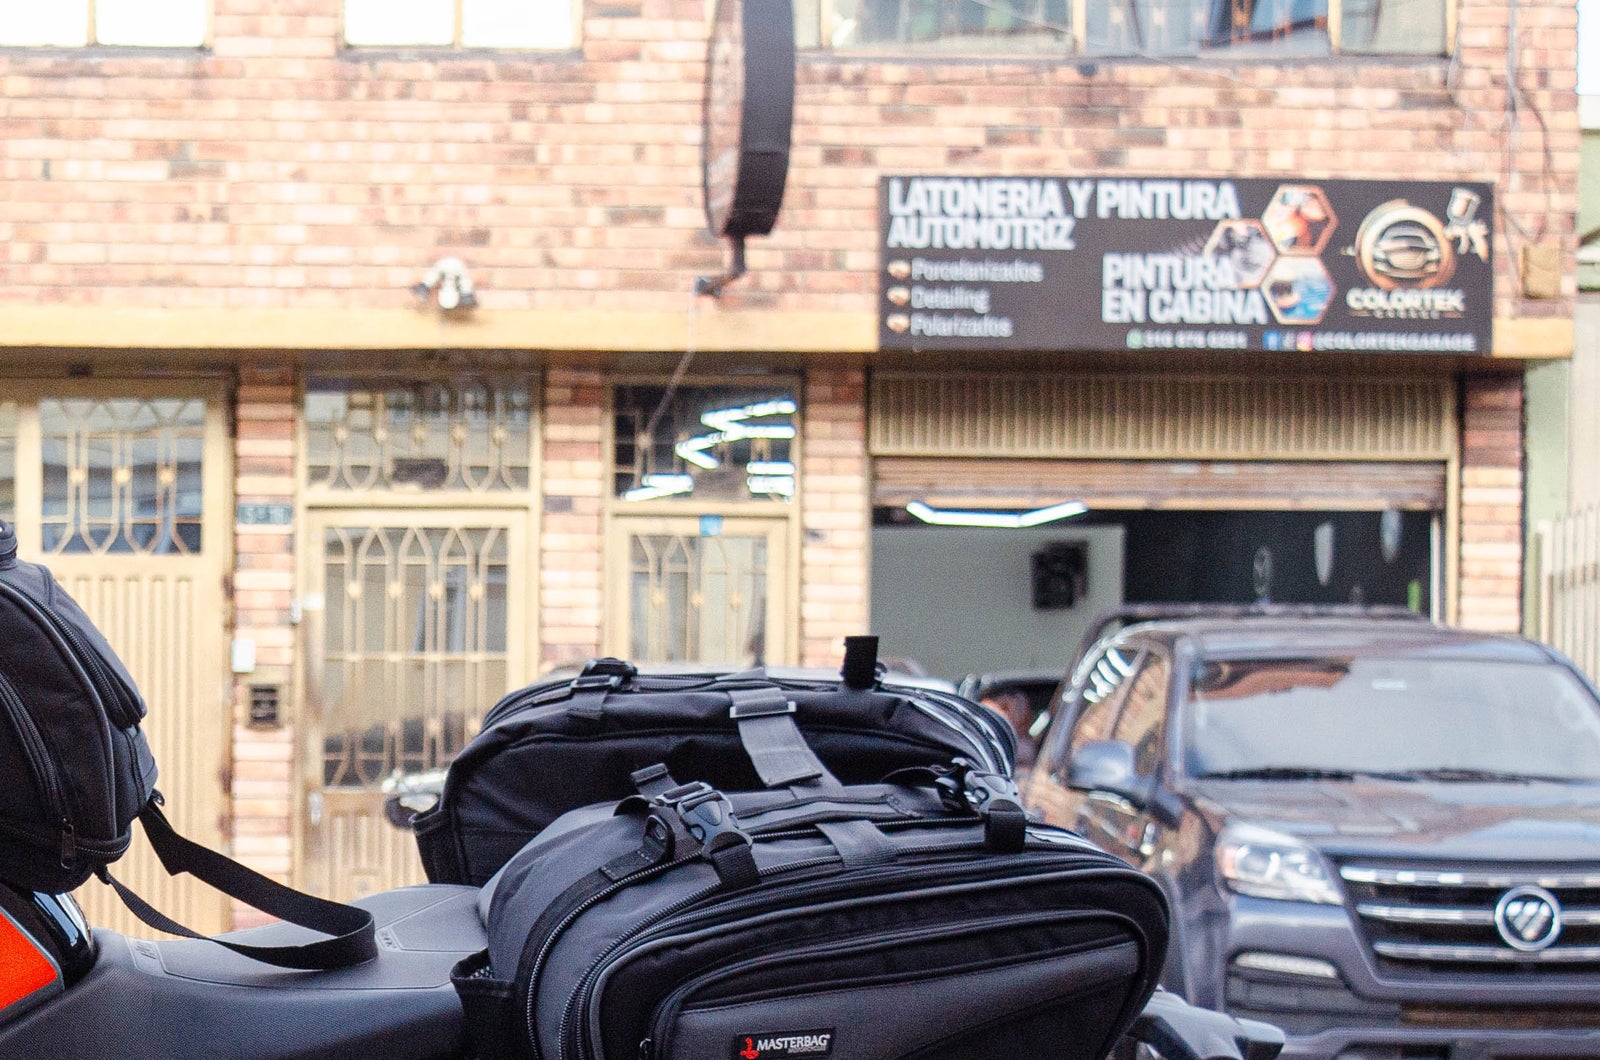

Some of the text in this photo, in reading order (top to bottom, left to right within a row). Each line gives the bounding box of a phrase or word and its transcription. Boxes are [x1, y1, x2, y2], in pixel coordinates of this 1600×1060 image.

[888, 178, 1242, 220] LATONERIA Y PINTURA
[886, 216, 1076, 250] AUTOMOTRIZ
[1102, 252, 1238, 290] PINTURA
[1102, 289, 1268, 325] EN CABINA
[1346, 287, 1466, 312] COLORTEK
[756, 1034, 828, 1052] MASTERBAG
